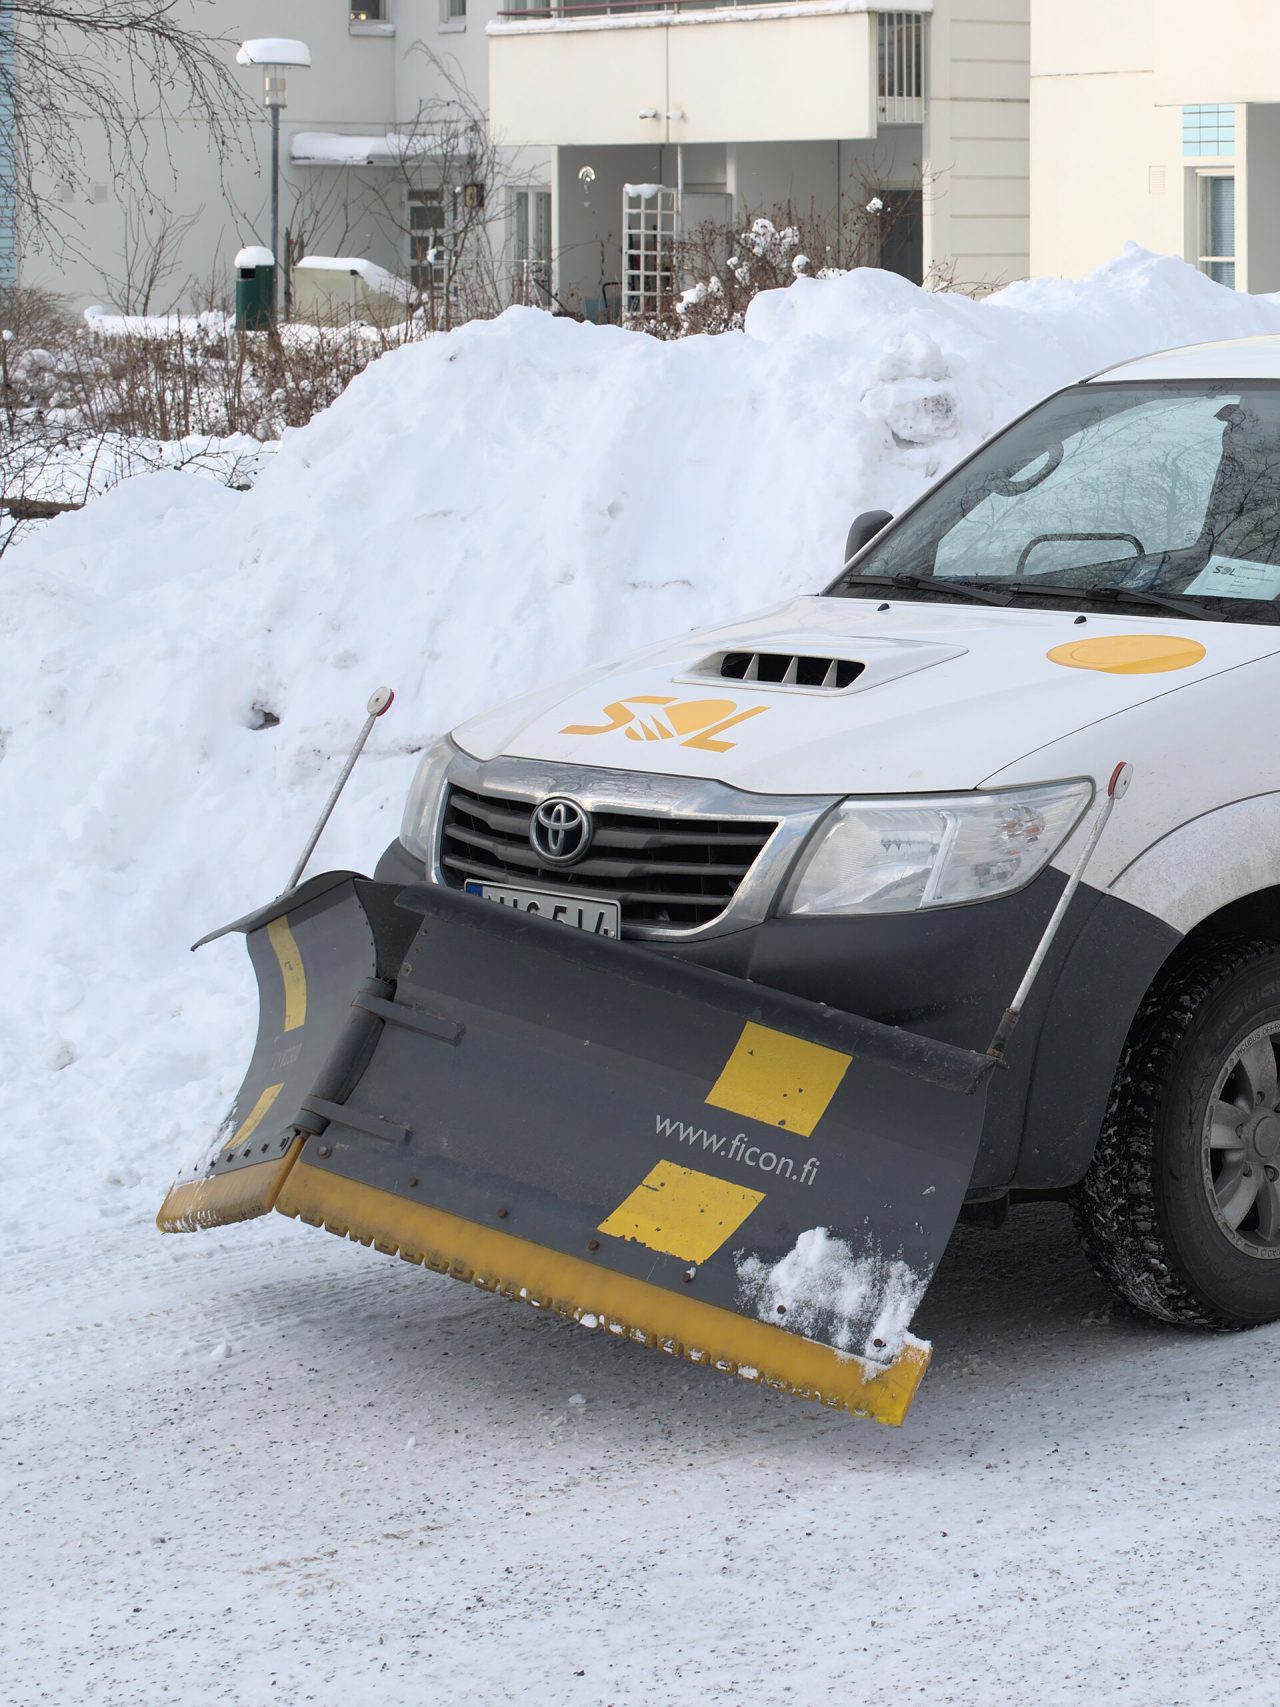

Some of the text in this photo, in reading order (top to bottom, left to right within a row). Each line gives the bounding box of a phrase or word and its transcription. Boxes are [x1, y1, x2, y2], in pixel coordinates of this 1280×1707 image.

[1212, 565, 1236, 577] SOL
[557, 695, 772, 753] SOL
[1235, 1031, 1261, 1058] INCUBUS
[655, 1114, 821, 1186] www.ficon.fi
